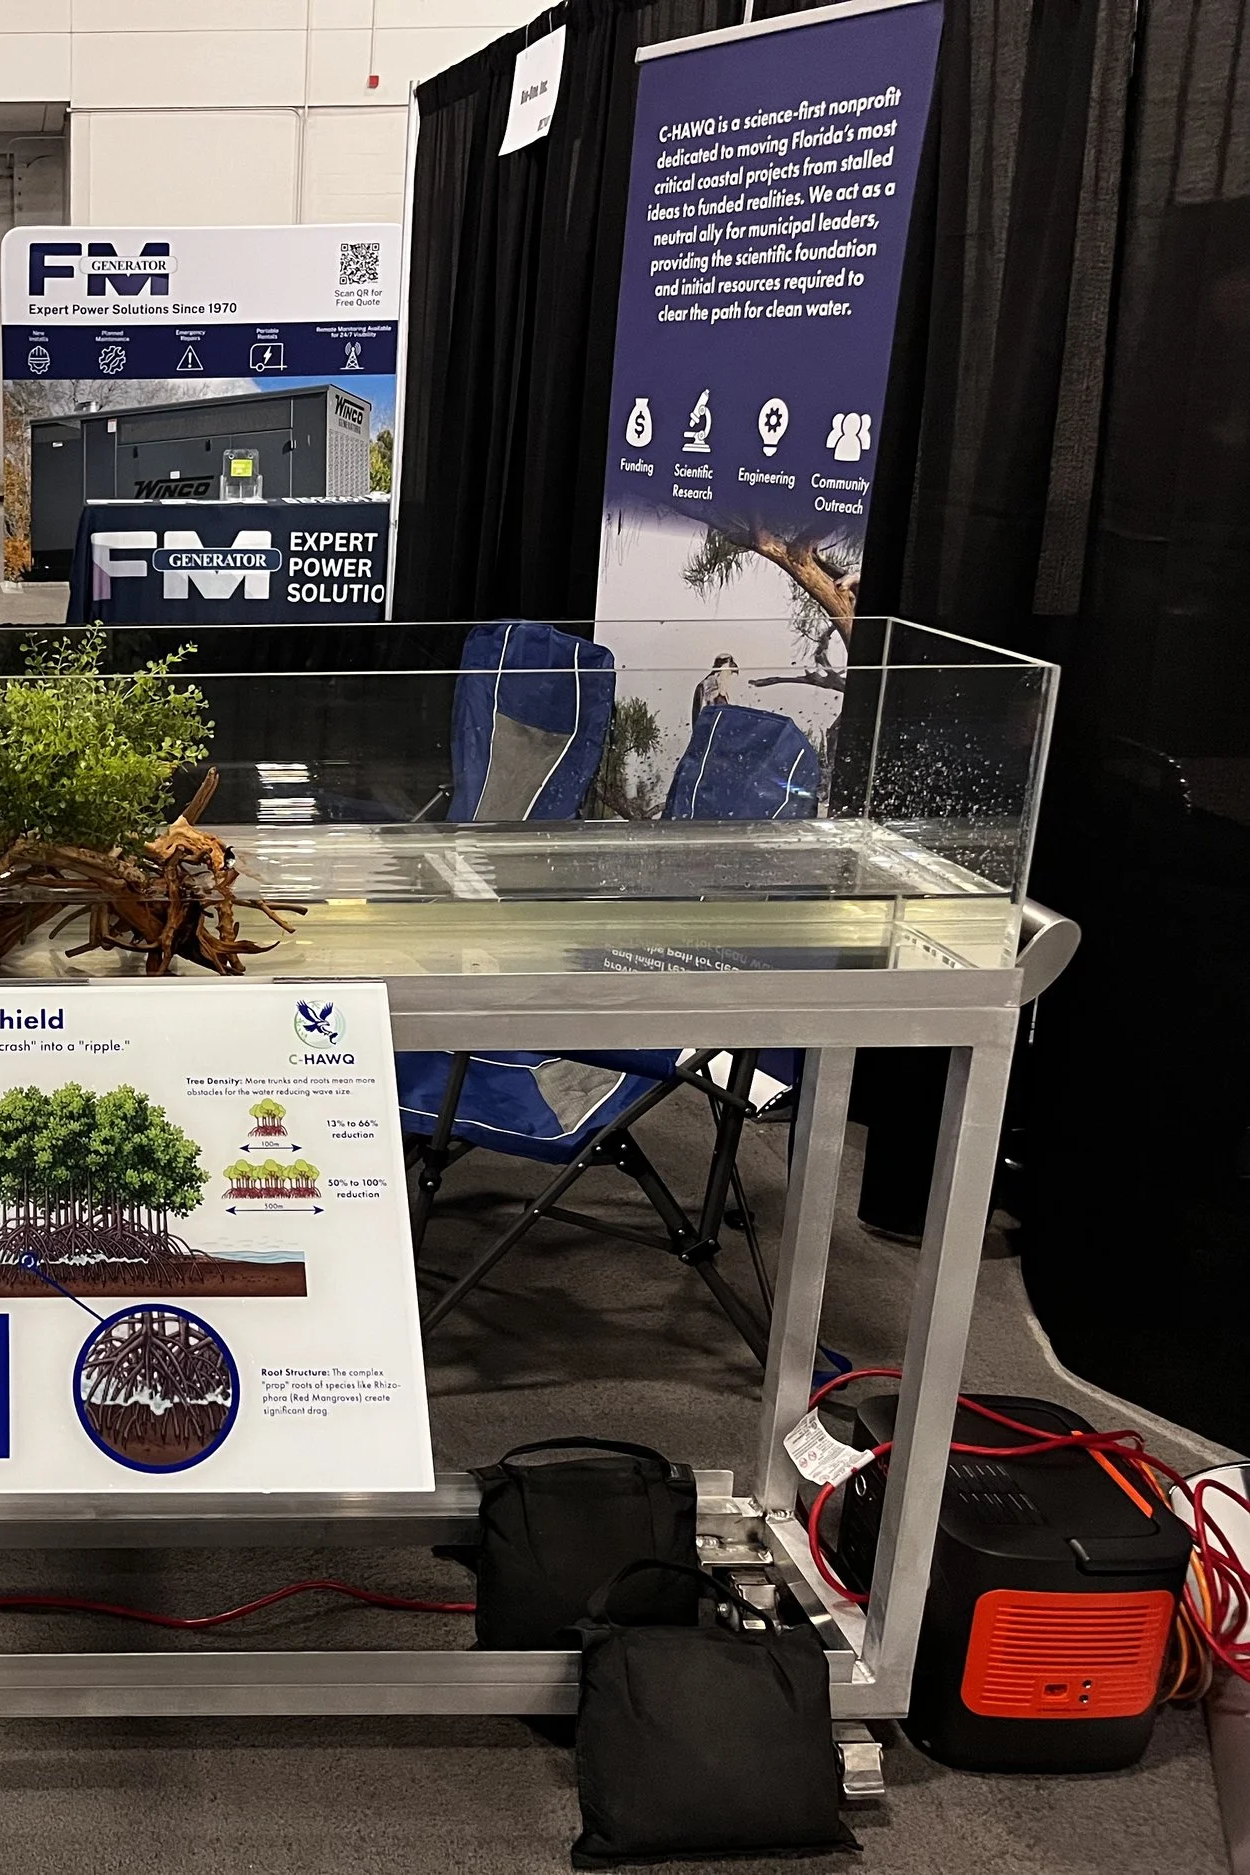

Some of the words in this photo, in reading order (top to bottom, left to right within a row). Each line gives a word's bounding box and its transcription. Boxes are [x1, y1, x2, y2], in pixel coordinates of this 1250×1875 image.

[659, 118, 715, 142] C-HAWQ
[718, 117, 728, 133] is
[731, 119, 740, 131] a
[744, 100, 826, 129] science-first
[829, 86, 901, 116] nonprofit
[657, 145, 718, 169] dedicated
[721, 145, 733, 161] to
[737, 138, 788, 158] moving
[792, 125, 854, 150] Florida's
[858, 120, 897, 140] most
[654, 171, 695, 195] critical
[697, 166, 742, 189] coastal
[746, 162, 799, 188] projects
[803, 159, 837, 176] from
[840, 147, 893, 171] stalled
[647, 206, 680, 221] ideas
[682, 204, 696, 217] to
[698, 198, 743, 217] funded
[747, 191, 804, 211] realities.
[809, 186, 832, 202] We
[836, 183, 859, 201] act
[862, 184, 882, 198] as
[884, 182, 896, 197] a
[653, 224, 696, 246] neutral
[699, 221, 723, 246] ally
[726, 223, 745, 240] for
[748, 214, 816, 240] municipal
[818, 210, 879, 232] leaders,
[91, 258, 167, 273] GENERATOR
[650, 251, 709, 276] providing
[711, 251, 732, 268] the
[735, 244, 792, 266] scientific
[795, 239, 877, 262] foundation
[29, 242, 170, 296] FM
[655, 279, 678, 298] and
[681, 277, 715, 294] initial
[718, 278, 781, 294] resources
[784, 268, 845, 294] required
[848, 271, 864, 286] to
[357, 289, 369, 297] QR
[29, 304, 68, 316] Expert
[72, 304, 109, 314] Power
[113, 303, 169, 315] Solutions
[172, 303, 205, 314] Since
[209, 303, 237, 313] 1970
[658, 306, 688, 322] clear
[690, 305, 709, 321] the
[711, 302, 741, 324] path
[744, 302, 763, 319] for
[766, 301, 802, 318] clean
[806, 300, 852, 317] water.
[335, 394, 364, 425] WINCO
[620, 458, 654, 475] Funding
[674, 464, 713, 479] Scientific
[738, 468, 795, 488] Engineering
[811, 474, 870, 494] Community
[134, 476, 214, 499] WINCO
[672, 486, 713, 500] Research
[815, 497, 863, 514] Outreach
[290, 532, 378, 551] EXPERT
[91, 531, 272, 601] FM
[168, 553, 267, 568] GENERATOR
[289, 558, 372, 577] POWER
[40, 1041, 62, 1051] into
[67, 1043, 74, 1051] a
[79, 1040, 130, 1054] "ripple."
[289, 1054, 355, 1065] C-HAWQ
[208, 1078, 242, 1086] Density:
[332, 1131, 374, 1139] reduction
[328, 1179, 348, 1187] 50%
[362, 1179, 387, 1187] 100%
[337, 1190, 379, 1198] reduction
[332, 1368, 346, 1376] The
[349, 1368, 383, 1380] complex
[262, 1381, 289, 1392] "prop"
[315, 1381, 322, 1389] of
[326, 1382, 355, 1392] species
[374, 1381, 401, 1389] Rhizo-
[263, 1394, 287, 1403] phora
[290, 1394, 309, 1403] (Red
[312, 1394, 362, 1403] Mangroves)
[264, 1407, 305, 1416] significant
